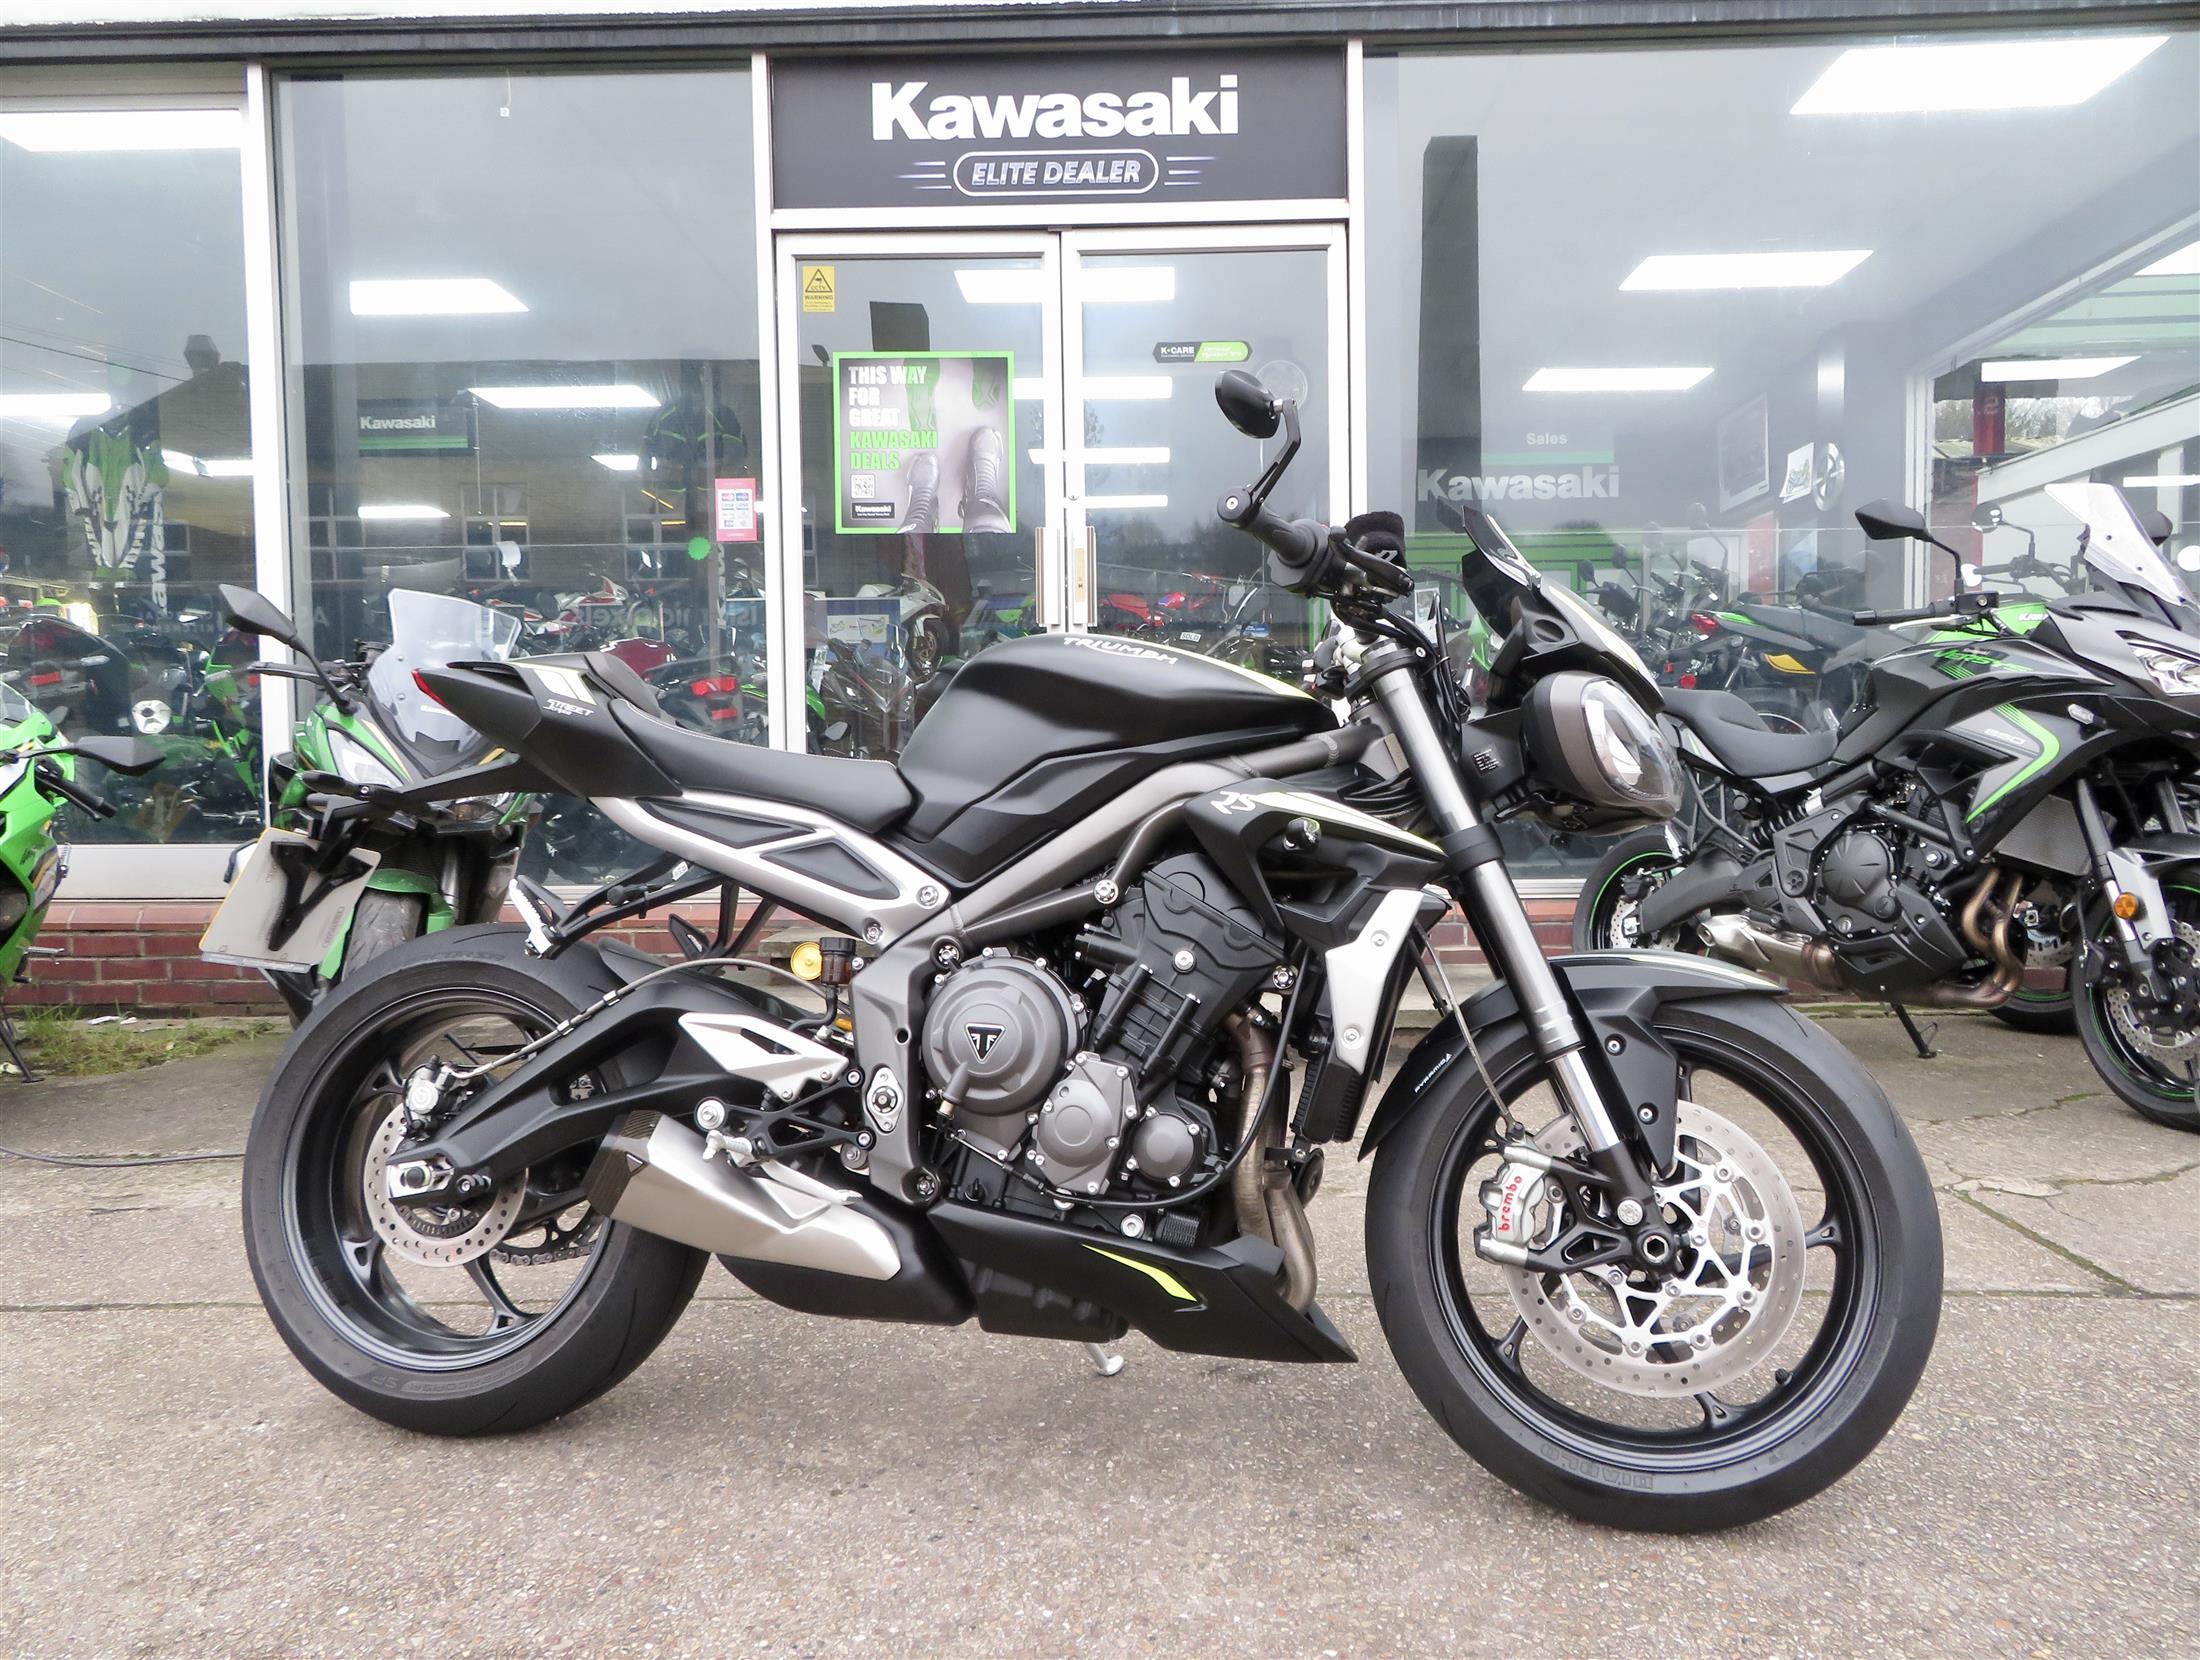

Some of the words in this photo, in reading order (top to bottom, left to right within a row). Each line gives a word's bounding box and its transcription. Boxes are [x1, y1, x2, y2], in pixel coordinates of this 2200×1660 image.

[871, 74, 1239, 141] Kawasaki
[971, 160, 1038, 186] ELITE
[1043, 159, 1141, 185] DEALER
[848, 365, 887, 385] THIS
[890, 365, 927, 385] WAY
[848, 386, 880, 406] FOR
[360, 415, 436, 430] Kawasaki
[848, 408, 900, 427] GREAT
[849, 430, 938, 449] KAWASAKI
[1526, 432, 1568, 446] Sales
[849, 451, 901, 470] DEALS
[1416, 465, 1620, 502] Kawasaki
[1063, 637, 1179, 665] TRIUMPH
[1210, 790, 1257, 815] RS
[1498, 1175, 1522, 1231] brembo
